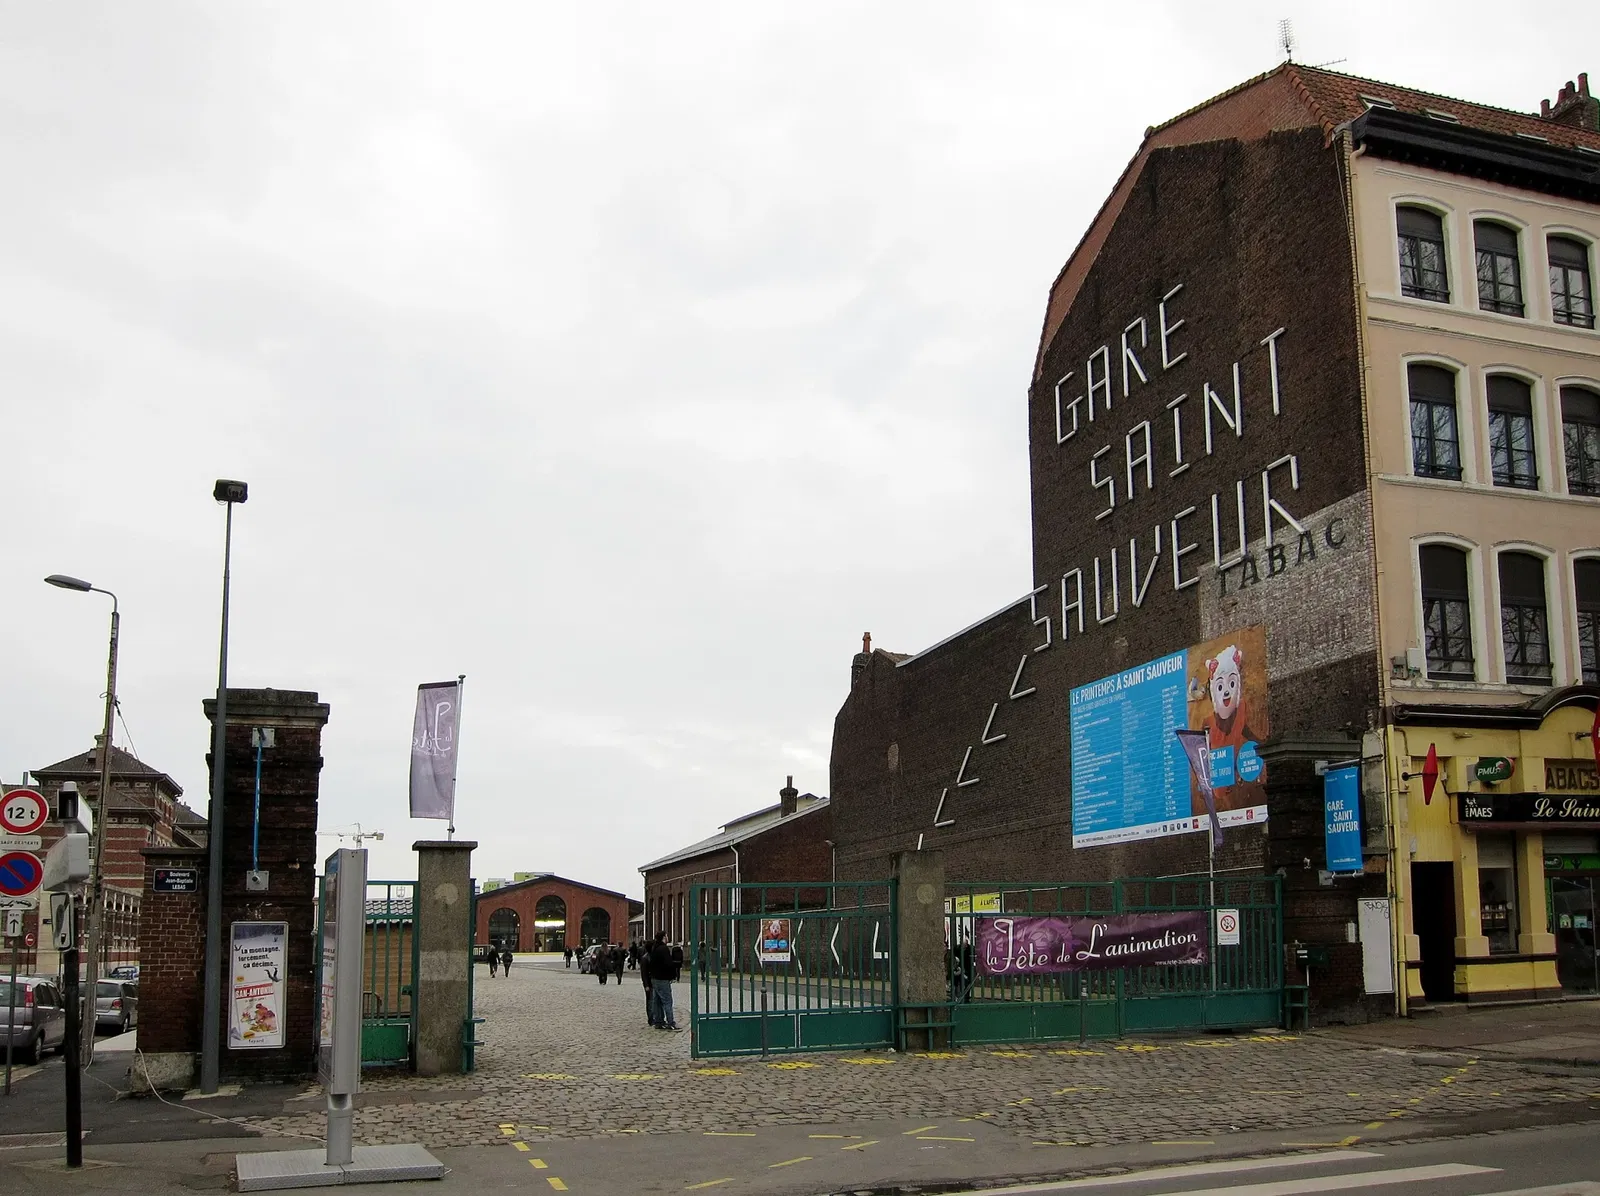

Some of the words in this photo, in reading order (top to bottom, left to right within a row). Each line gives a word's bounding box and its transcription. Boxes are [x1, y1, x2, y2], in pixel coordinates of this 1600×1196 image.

[1055, 283, 1188, 445] GARE
[1090, 327, 1286, 521] SAINT
[1029, 454, 1306, 653] SAUVEUR
[1216, 517, 1347, 599] TABAC
[1072, 691, 1080, 706] LE
[1080, 679, 1115, 703] PRINTEMPS
[1116, 674, 1122, 692] À
[1123, 668, 1145, 688] SAINT
[1146, 655, 1183, 681] SAUVEUR
[1477, 767, 1496, 776] PMU
[1545, 766, 1600, 791] ABACS
[7, 807, 25, 819] 12
[30, 809, 36, 820] t
[1327, 800, 1344, 811] GARE
[1333, 810, 1353, 822] SAINT
[1469, 807, 1493, 818] MAES
[1532, 798, 1556, 818] Le
[1559, 798, 1600, 818] Sain
[1327, 821, 1359, 834] SAUVEUR
[991, 918, 1048, 973] Fête
[1056, 942, 1071, 964] de
[1076, 922, 1199, 961] L'animation
[986, 941, 999, 966] la
[235, 986, 274, 999] SAN-ANTONIO
